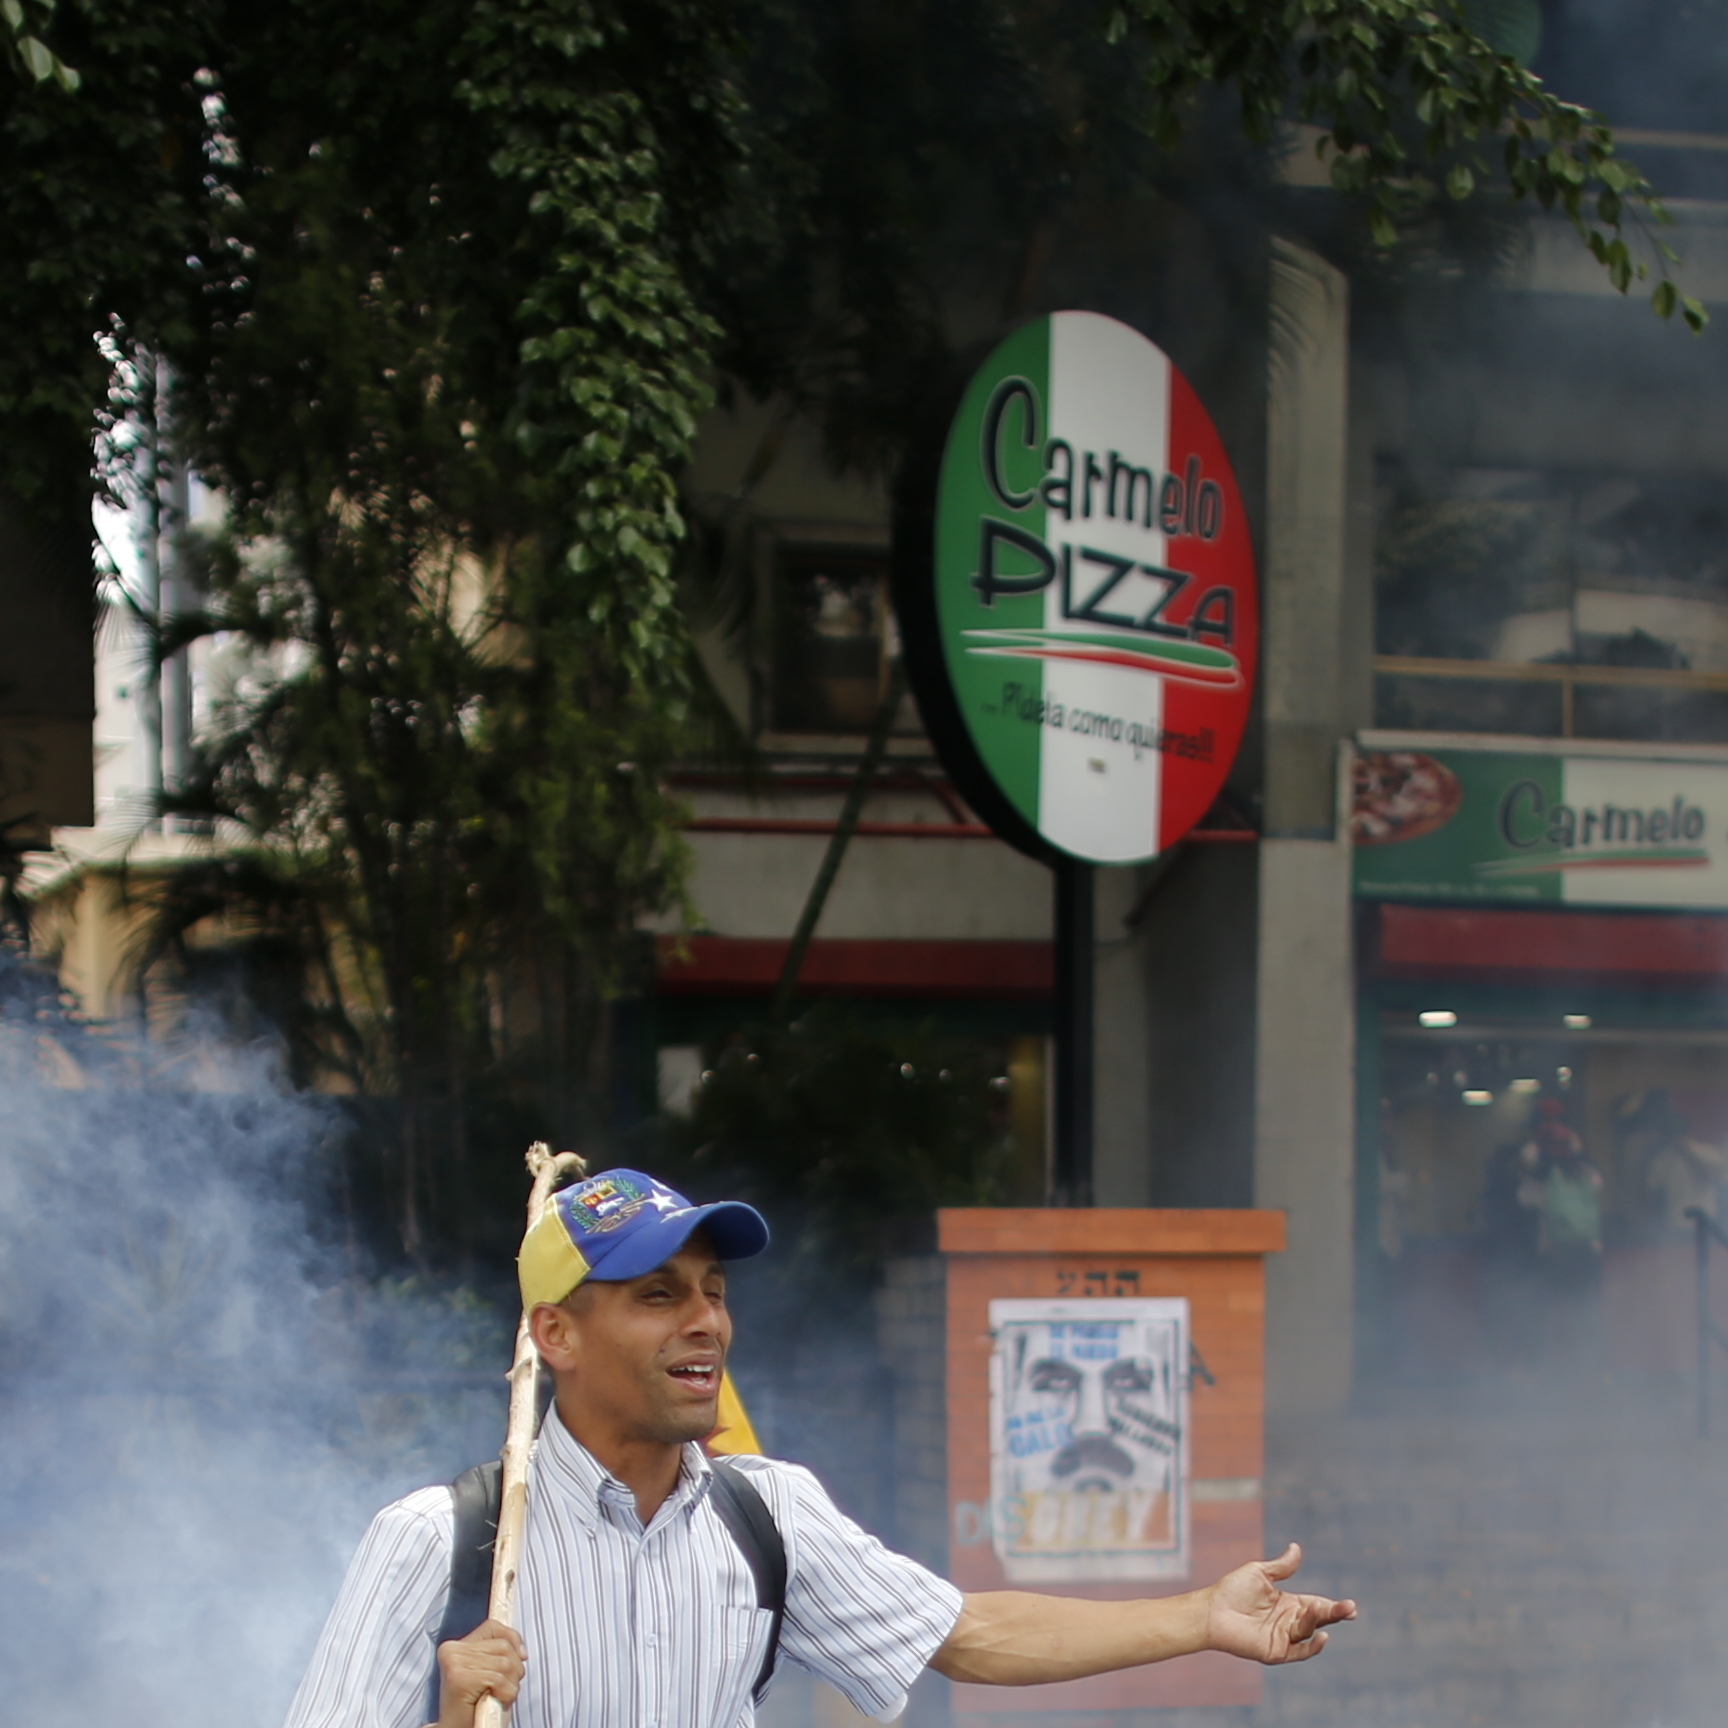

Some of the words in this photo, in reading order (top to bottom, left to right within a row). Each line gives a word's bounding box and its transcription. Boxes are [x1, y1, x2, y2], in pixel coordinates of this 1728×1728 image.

[980, 375, 1222, 540] Carmelo
[970, 514, 1235, 648] PIZZA
[1068, 705, 1125, 742] como
[1496, 779, 1706, 852] Carmelo
